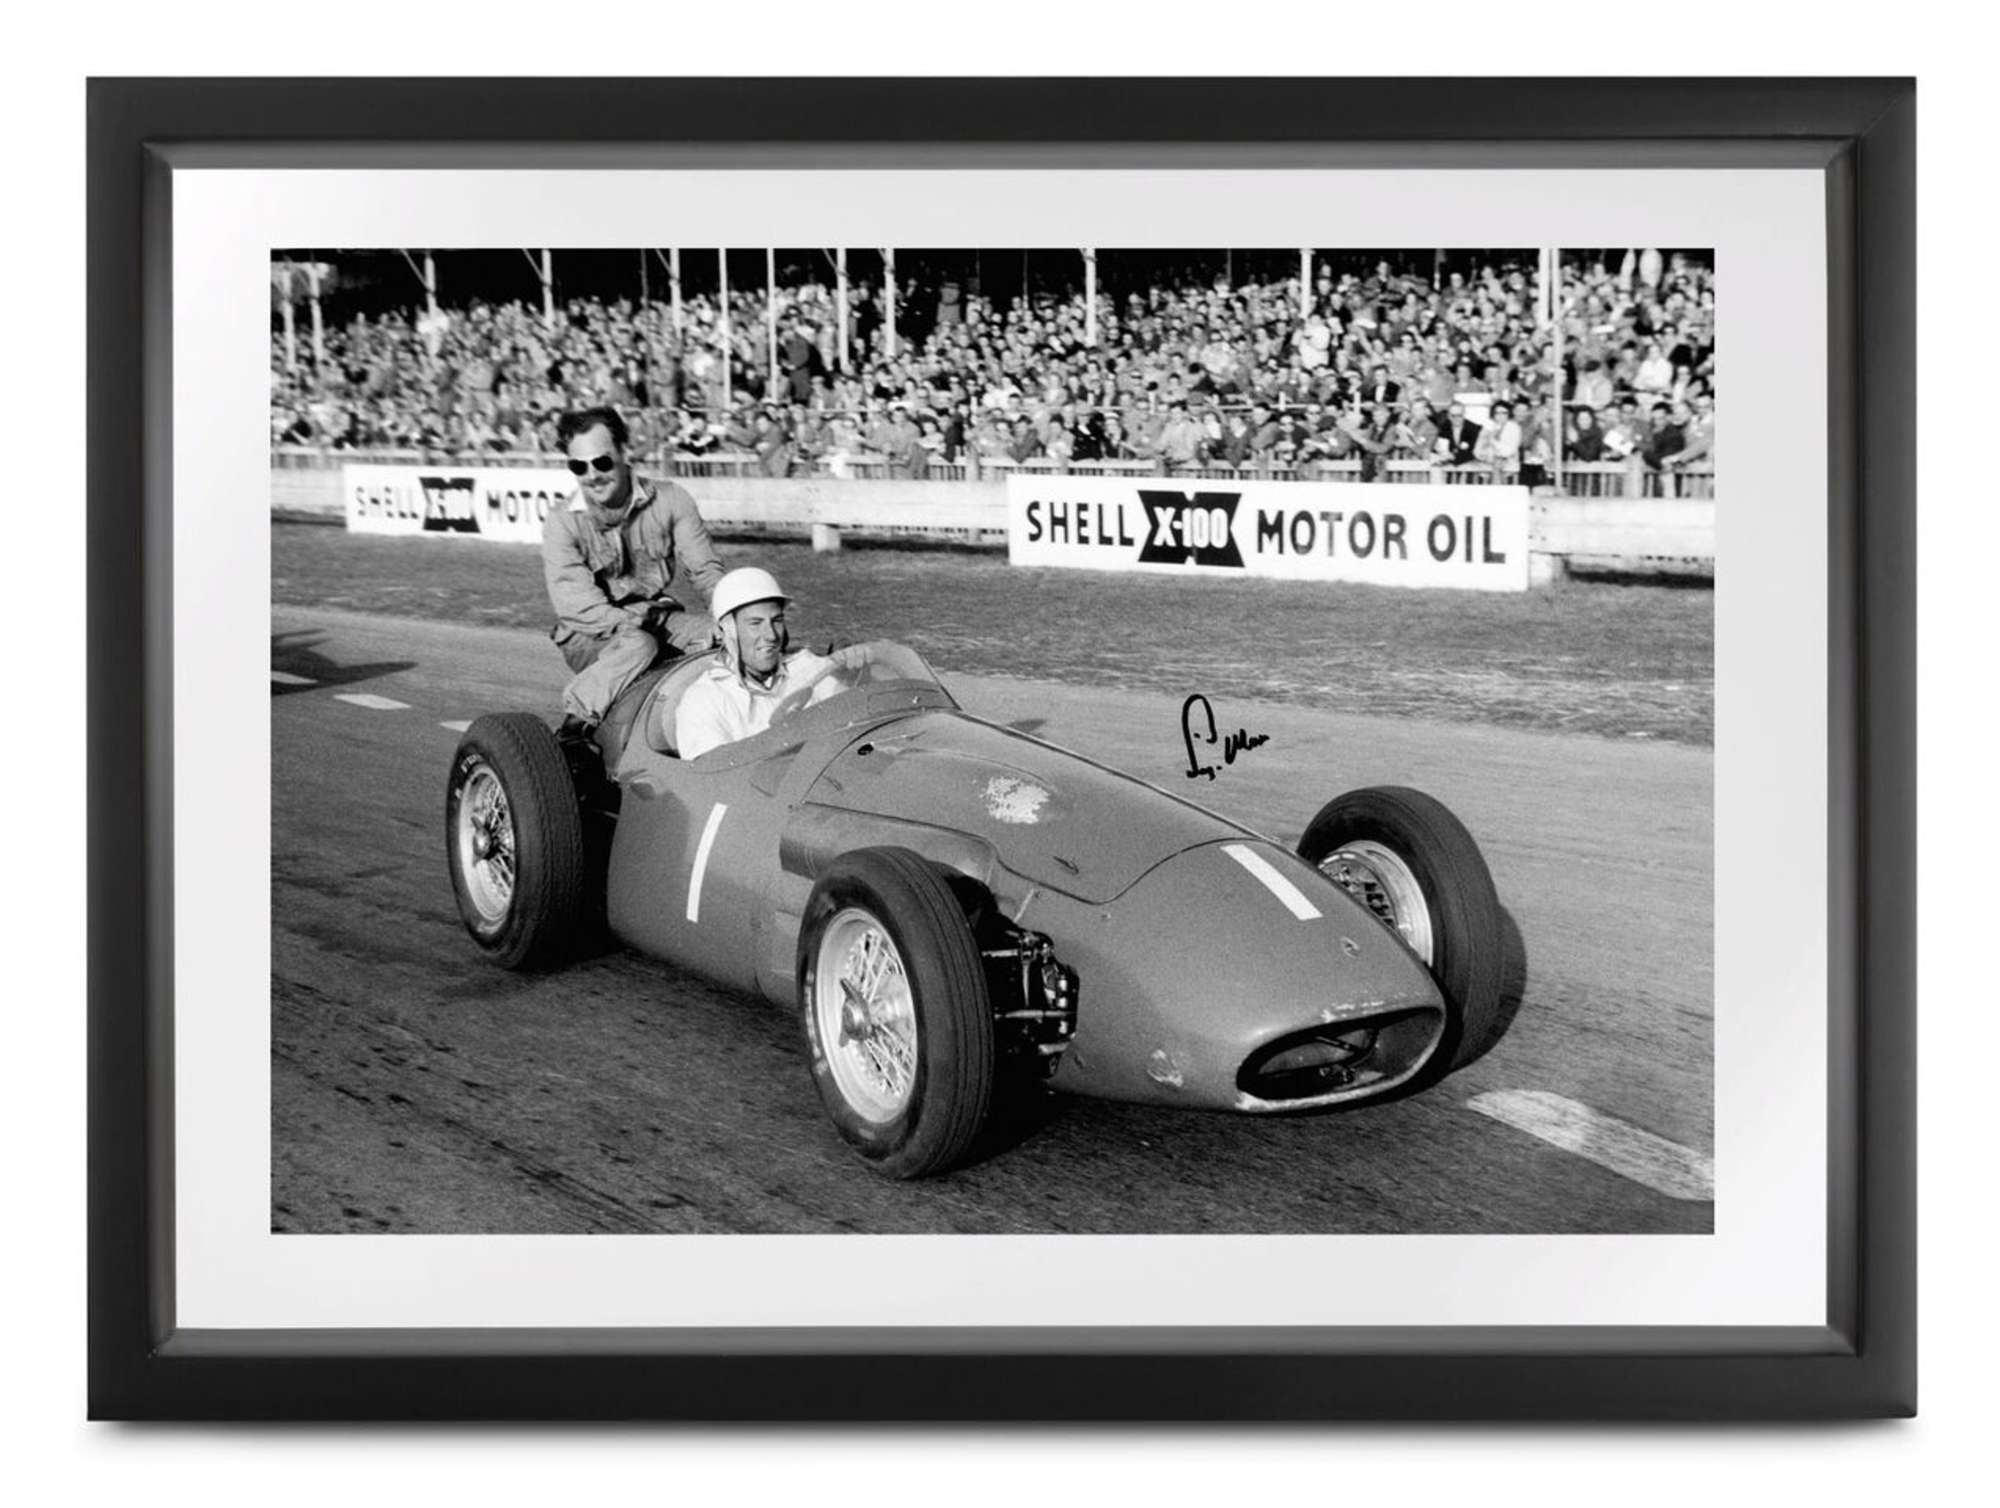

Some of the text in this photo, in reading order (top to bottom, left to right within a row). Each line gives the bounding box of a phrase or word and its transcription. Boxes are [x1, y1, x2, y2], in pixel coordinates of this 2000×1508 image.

[357, 486, 419, 519] SHELL
[1026, 501, 1506, 563] SHELL X-100 MOTOR OIL
[686, 802, 728, 923] 1
[1220, 844, 1323, 921] 1
